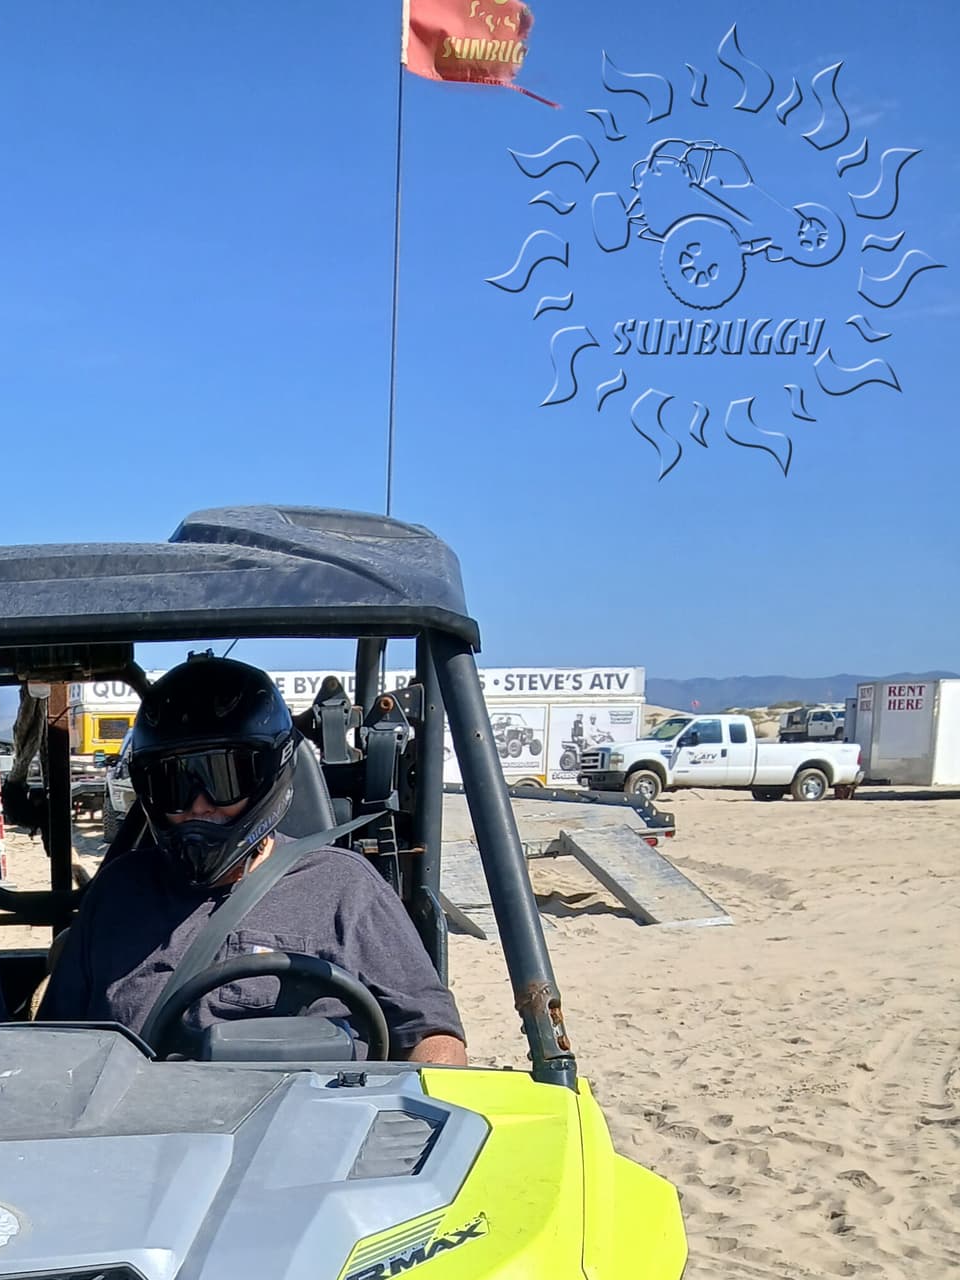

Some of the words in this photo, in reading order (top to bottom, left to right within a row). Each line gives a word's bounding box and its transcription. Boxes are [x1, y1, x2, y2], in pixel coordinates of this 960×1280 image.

[294, 676, 318, 694] BY
[504, 673, 583, 691] STEVE'S
[590, 673, 630, 690] ATV
[887, 685, 926, 697] RENT
[887, 698, 924, 711] HERE
